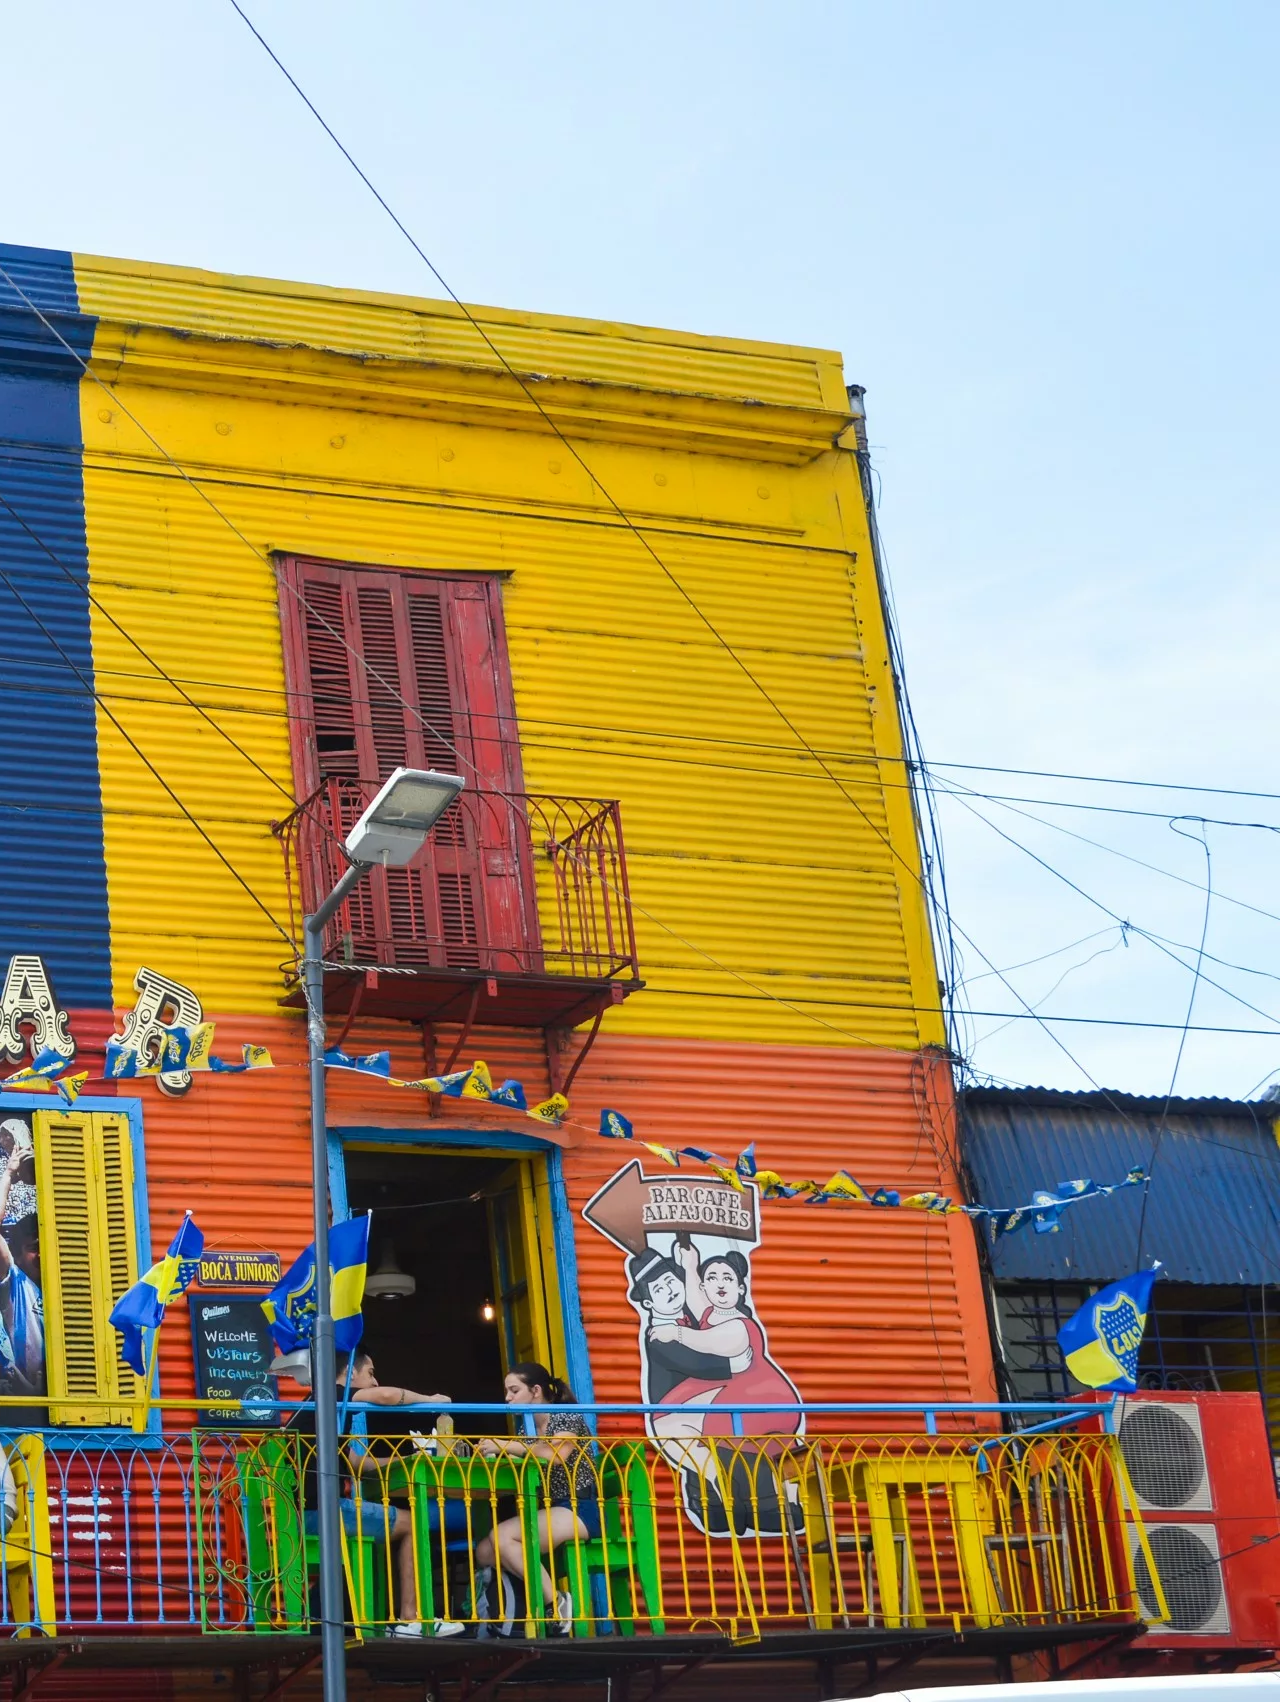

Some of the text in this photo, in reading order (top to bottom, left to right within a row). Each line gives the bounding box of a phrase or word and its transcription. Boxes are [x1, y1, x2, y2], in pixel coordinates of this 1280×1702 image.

[650, 1187, 739, 1210] BAR CAFE
[644, 1204, 750, 1228] ALFAJORES
[201, 1262, 280, 1283] BOCA JUNIORS
